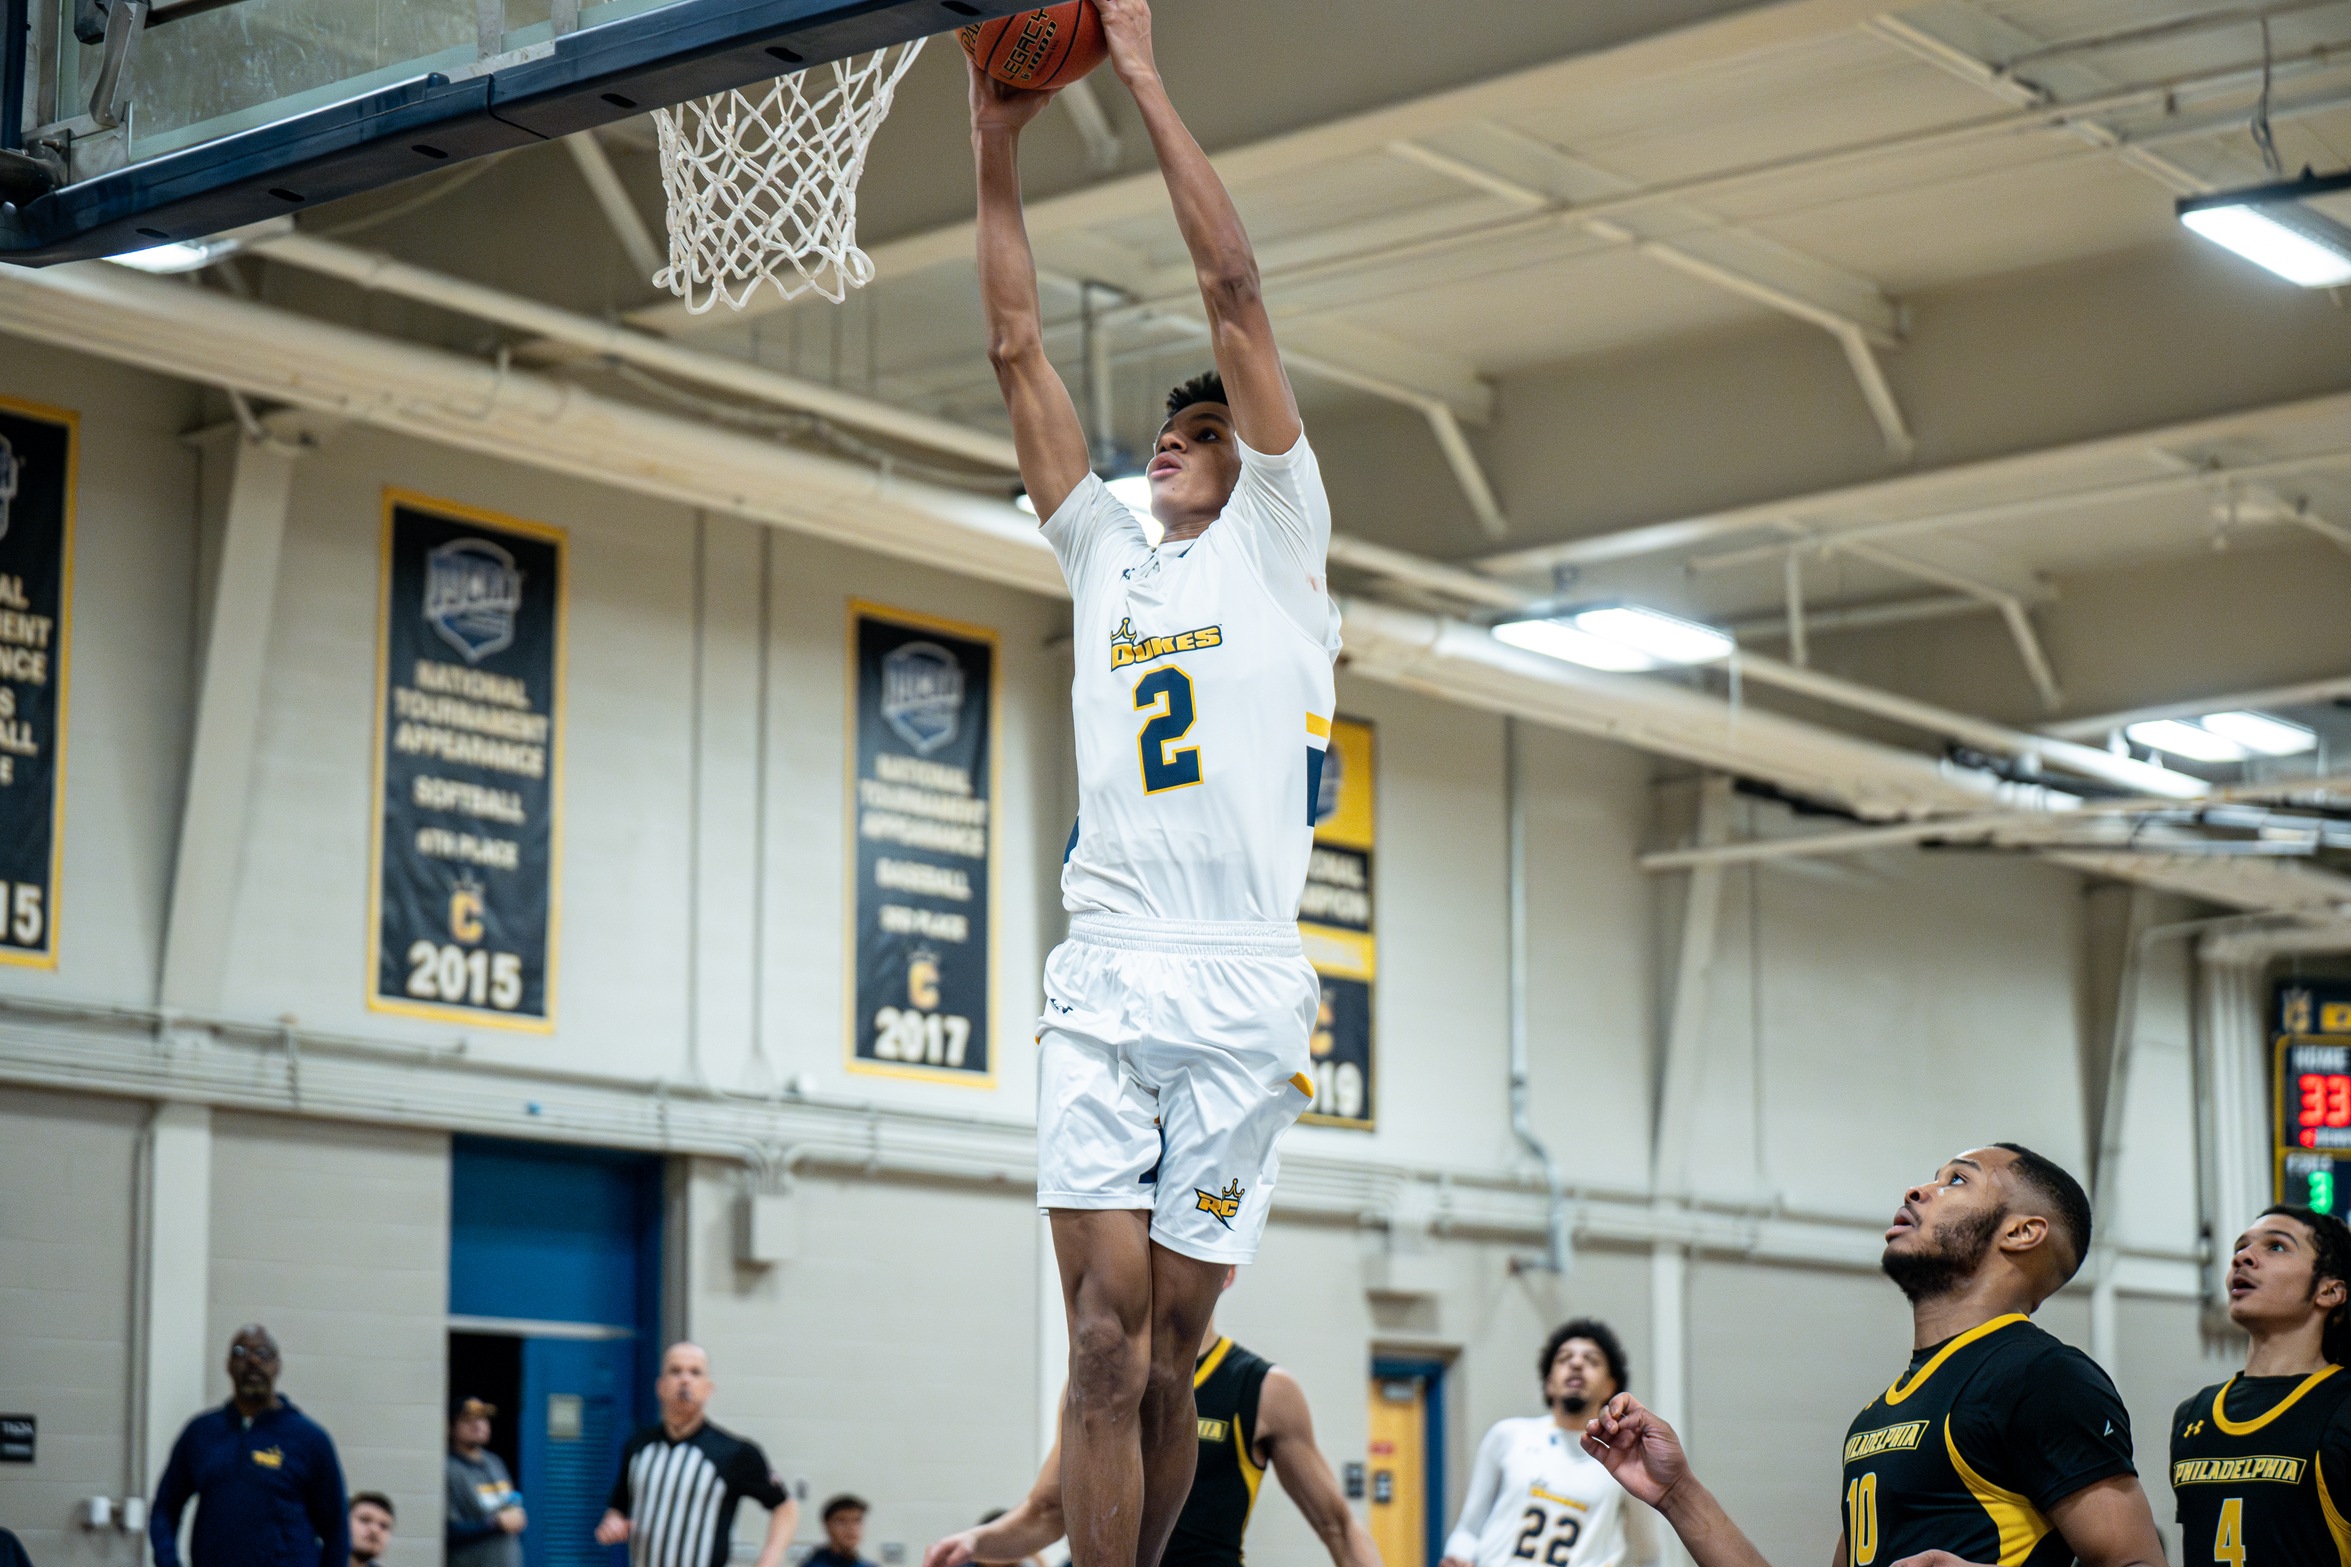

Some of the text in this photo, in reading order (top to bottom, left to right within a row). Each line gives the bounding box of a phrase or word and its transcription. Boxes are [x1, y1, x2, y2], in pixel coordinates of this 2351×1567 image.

[1111, 624, 1222, 672] DUKES
[1132, 663, 1204, 796] 2
[453, 893, 483, 942] C
[408, 941, 521, 1008] 2015
[910, 962, 939, 1009] C
[876, 1008, 969, 1066] 2017
[1310, 1059, 1364, 1117] 19
[2298, 1074, 2351, 1127] 33
[1194, 1187, 1239, 1232] RC
[2174, 1457, 2298, 1484] PHILADELPHIA
[1513, 1505, 1581, 1567] 22
[1846, 1472, 1878, 1567] 10
[2214, 1498, 2246, 1567] 4
